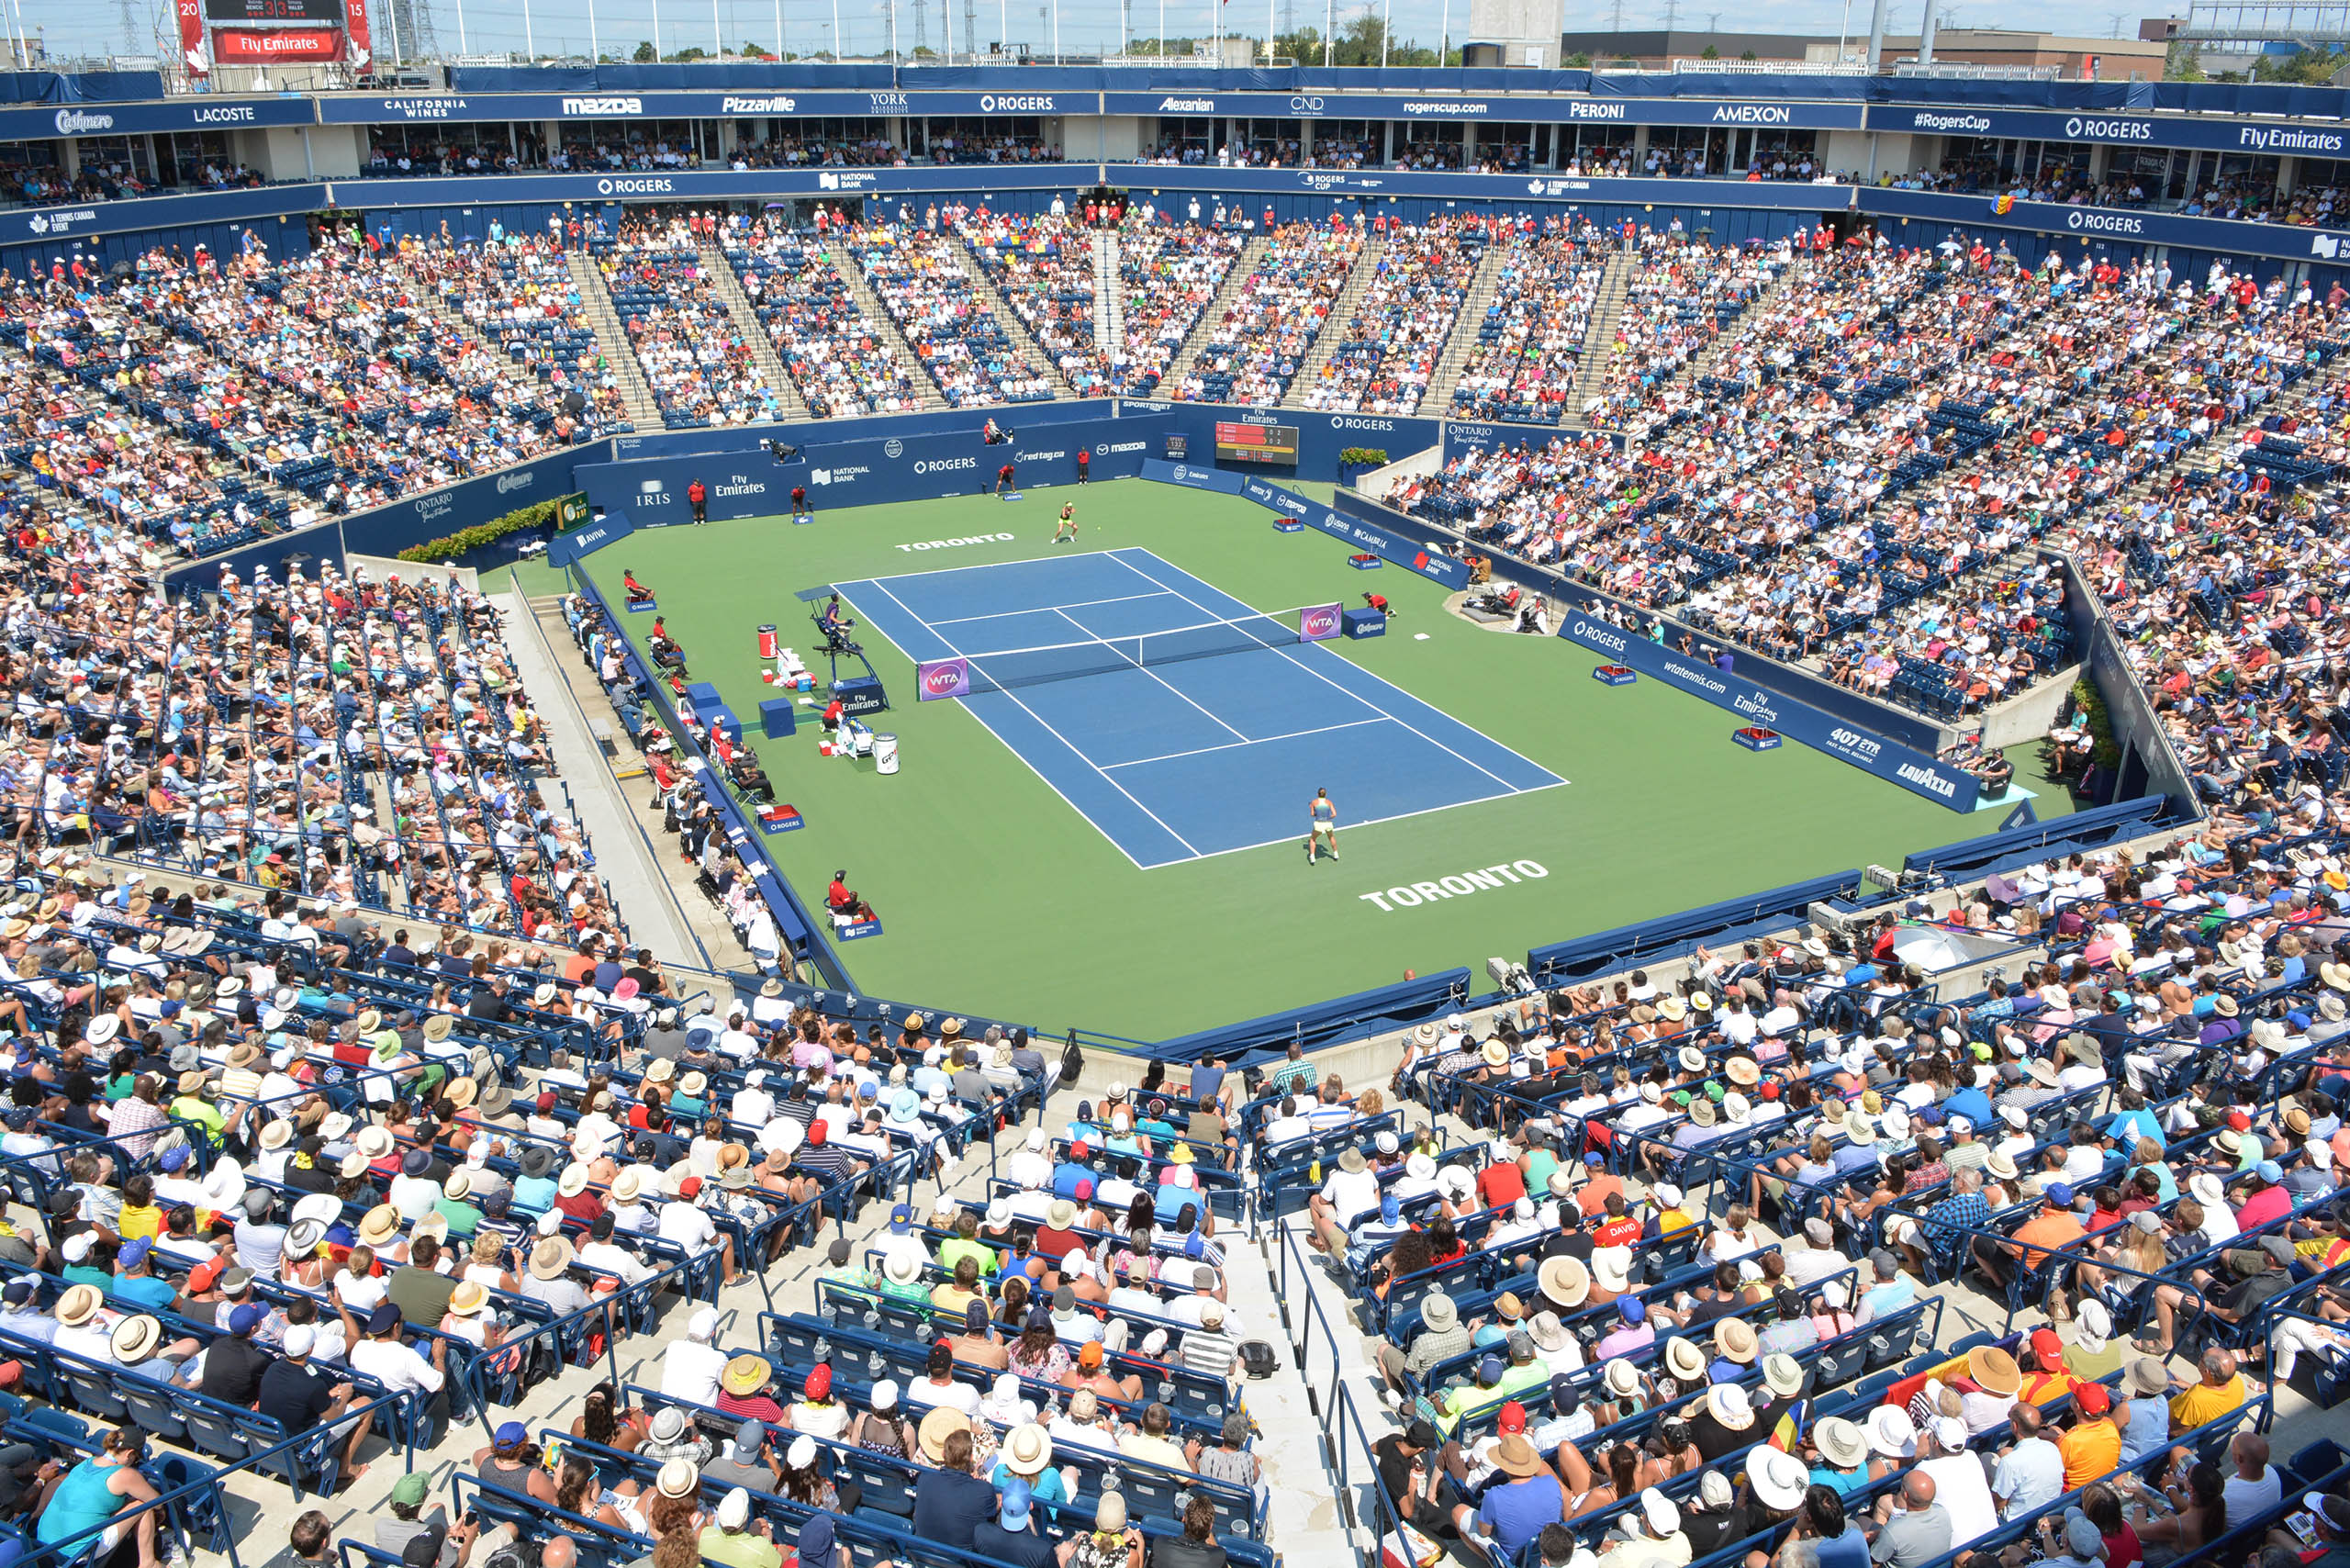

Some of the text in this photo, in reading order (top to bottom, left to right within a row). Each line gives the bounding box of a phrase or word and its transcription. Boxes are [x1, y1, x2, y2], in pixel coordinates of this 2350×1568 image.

[181, 4, 198, 16] 20
[265, 1, 274, 15] 3
[278, 1, 287, 15] 3
[350, 4, 363, 16] 15
[241, 38, 319, 52] Fly Emirates
[385, 99, 466, 110] CALIFORNIA
[722, 96, 796, 113] Pizzaville
[870, 94, 908, 105] YORK
[998, 95, 1054, 110] ROGERS
[1158, 96, 1214, 112] Alexanian
[1291, 96, 1324, 110] CND
[194, 107, 254, 123] LACOSTE
[405, 108, 448, 118] WINES
[1404, 102, 1487, 114] rogerscup.com
[1570, 102, 1625, 118] PERONI
[1713, 106, 1790, 123] AMEXON
[55, 108, 114, 134] Cashmere
[1914, 113, 1990, 132] #RogersCup
[2085, 120, 2151, 139] ROGERS
[2241, 128, 2342, 150] Fly Emirates
[841, 173, 876, 182] NATIONAL
[841, 180, 862, 188] BANK
[1315, 175, 1345, 184] ROGERS
[616, 179, 672, 192] ROGERS
[50, 210, 95, 223] A TENNIS CANADA
[2085, 214, 2143, 233] ROGERS
[51, 222, 69, 232] EVENT
[1123, 401, 1171, 410] SPORTSNET
[1242, 414, 1278, 424] Emirates
[1345, 418, 1393, 431] ROGERS
[1449, 424, 1493, 436] ONTARIO
[834, 465, 869, 476] NATIONAL
[928, 457, 976, 472] ROGERS
[732, 475, 746, 484] Fly
[834, 475, 856, 483] BANK
[715, 481, 766, 497] Emirates
[415, 492, 453, 512] ONTARIO
[636, 493, 671, 506] IRIS
[586, 529, 607, 543] AVIVA
[896, 532, 1015, 552] TORONTO
[1360, 531, 1388, 549] CAMBRIA
[1425, 565, 1440, 576] BANK
[1427, 557, 1452, 573] NATIONAL
[1308, 617, 1334, 628] WTA
[1584, 626, 1627, 652] ROGERS
[928, 674, 959, 686] WTA
[1664, 661, 1726, 694] wtatennis.com
[842, 699, 879, 711] Emirates
[1754, 691, 1768, 705] Fly
[1734, 694, 1777, 722] Emirates
[1830, 727, 1861, 747] 407
[1859, 738, 1882, 755] ETR
[1897, 762, 1955, 798] LAVAZZA
[778, 821, 800, 829] ROGERS
[1359, 859, 1549, 911] TORONTO
[1609, 1223, 1636, 1237] DAVID
